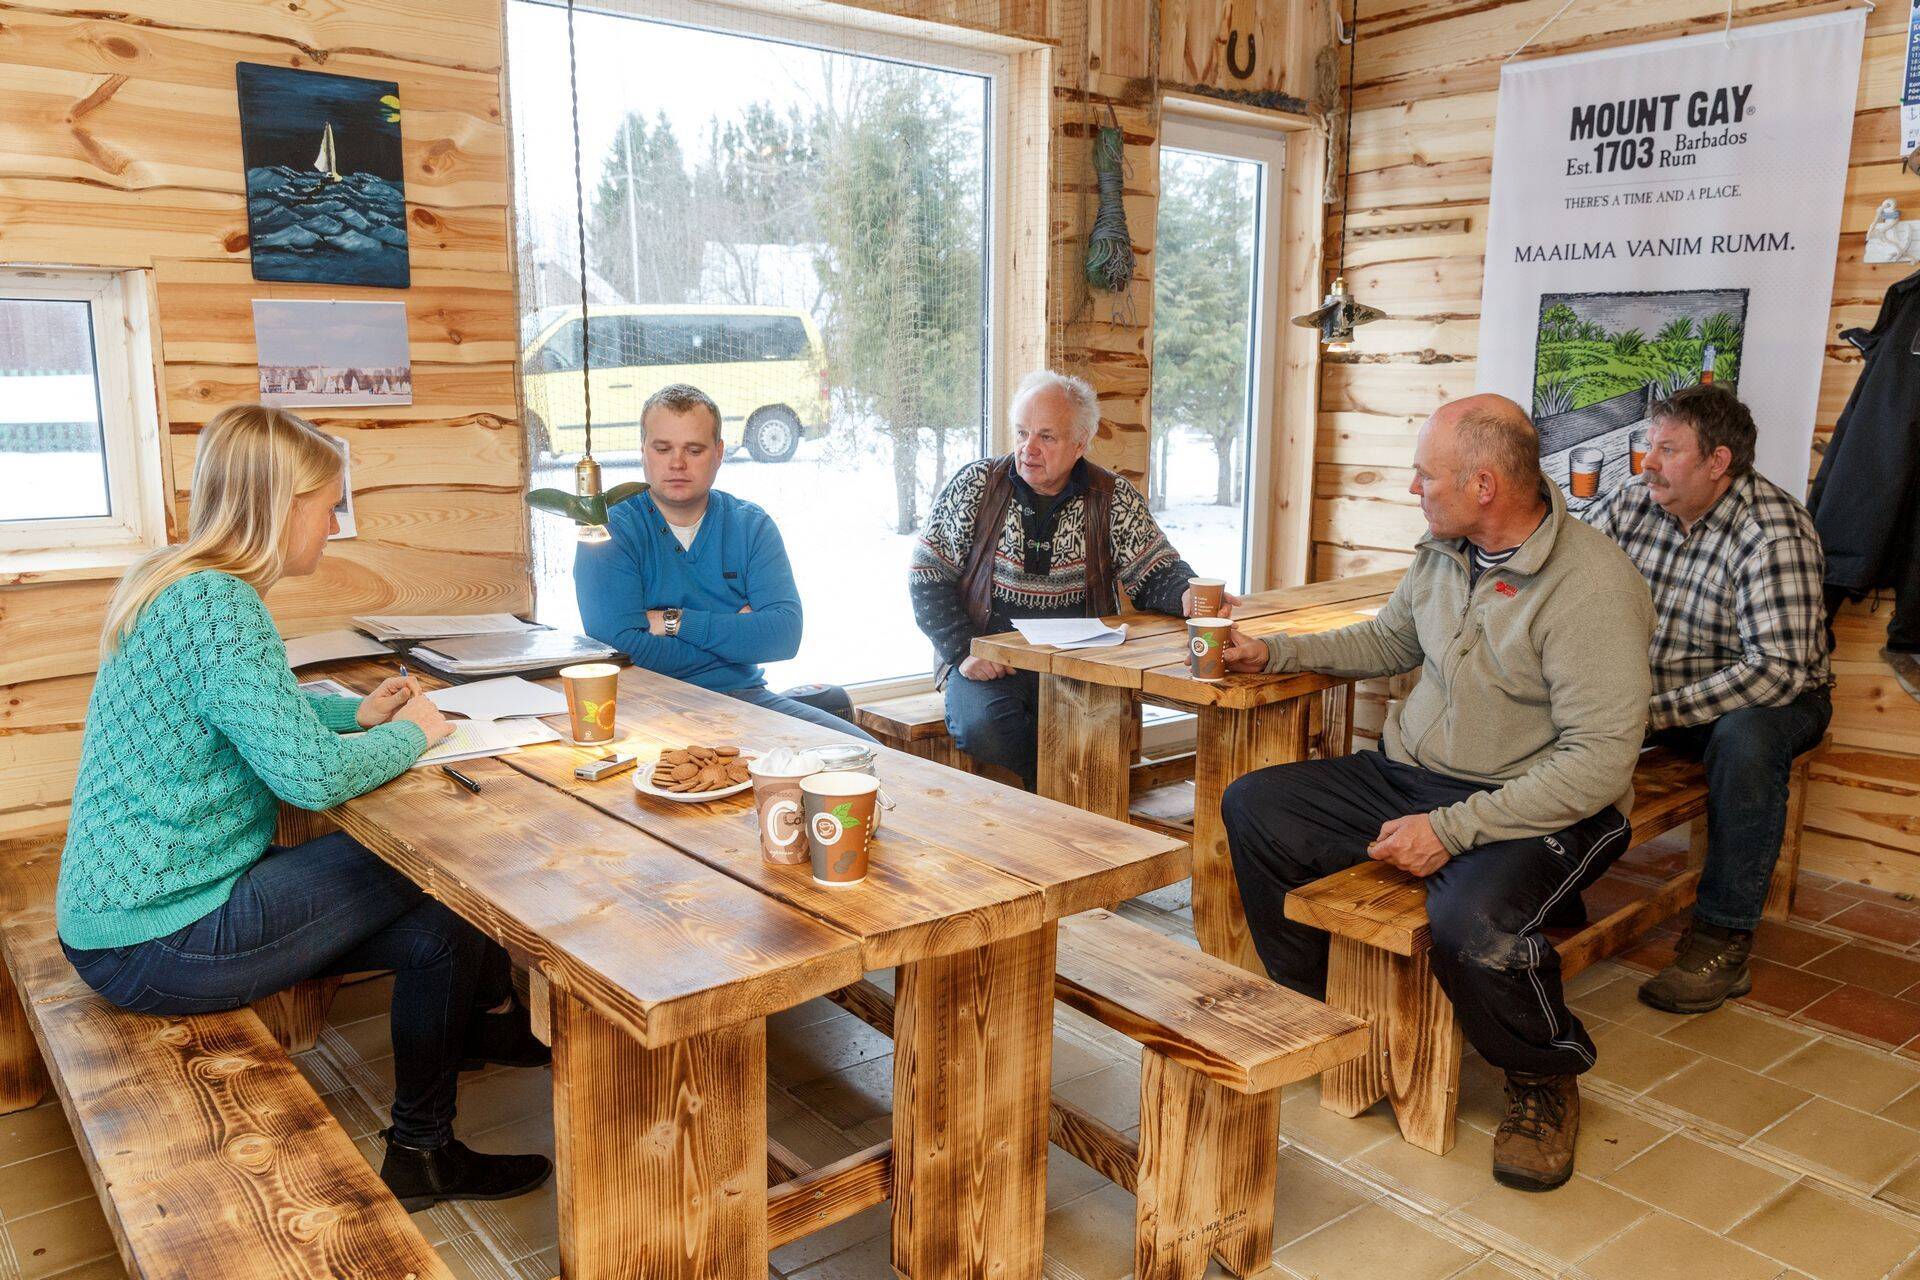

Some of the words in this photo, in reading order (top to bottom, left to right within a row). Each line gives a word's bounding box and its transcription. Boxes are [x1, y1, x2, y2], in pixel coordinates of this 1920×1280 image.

[1570, 94, 1680, 141] MOUNT
[1687, 84, 1752, 128] GAY
[1675, 128, 1747, 151] Barbados
[1566, 158, 1592, 176] Est.
[1593, 137, 1655, 173] 1703
[1659, 150, 1696, 168] Rum
[1565, 195, 1609, 209] THERE'S
[1612, 194, 1621, 206] A
[1624, 191, 1653, 205] TIME
[1656, 189, 1684, 203] AND
[1687, 188, 1695, 201] A
[1699, 184, 1741, 200] PLACE.
[1514, 241, 1617, 263] MAAILMA
[1626, 236, 1702, 257] VANIM
[1711, 232, 1795, 254] RUMM.
